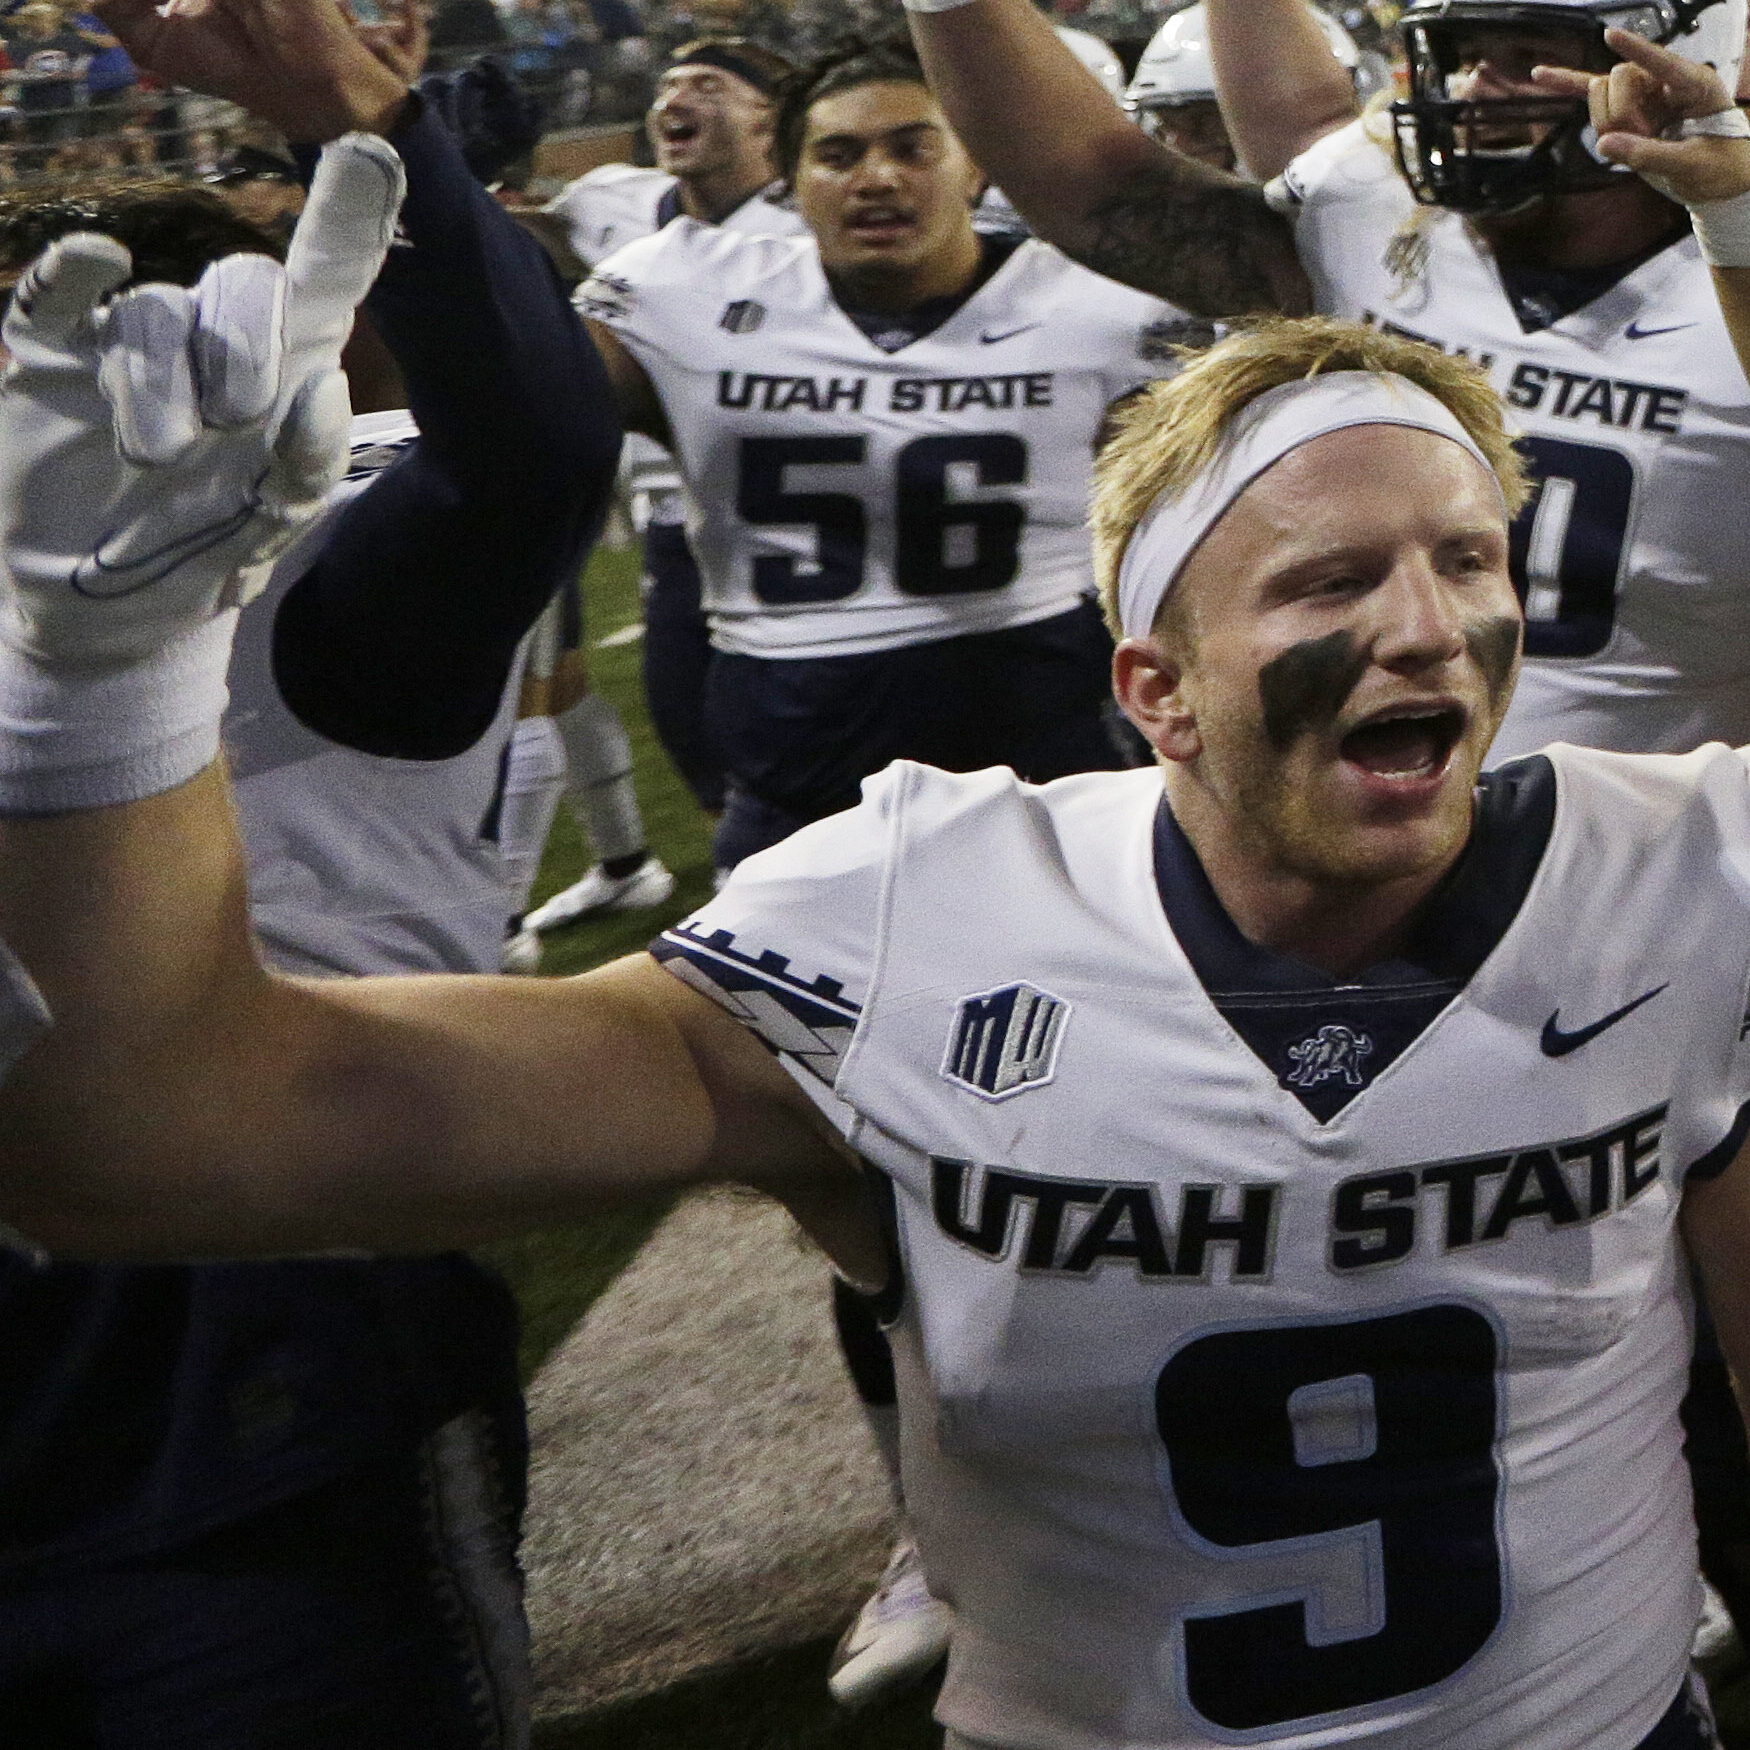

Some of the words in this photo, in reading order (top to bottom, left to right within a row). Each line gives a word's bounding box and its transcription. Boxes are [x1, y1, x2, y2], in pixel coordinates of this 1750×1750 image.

[719, 369, 869, 413] UTAH
[888, 372, 1055, 413] STATE
[1506, 362, 1690, 436] STATE
[737, 432, 1031, 604] 56
[928, 1152, 1281, 1287] UTAH
[1328, 1100, 1671, 1277] STATE
[1155, 1300, 1510, 1736] 9
